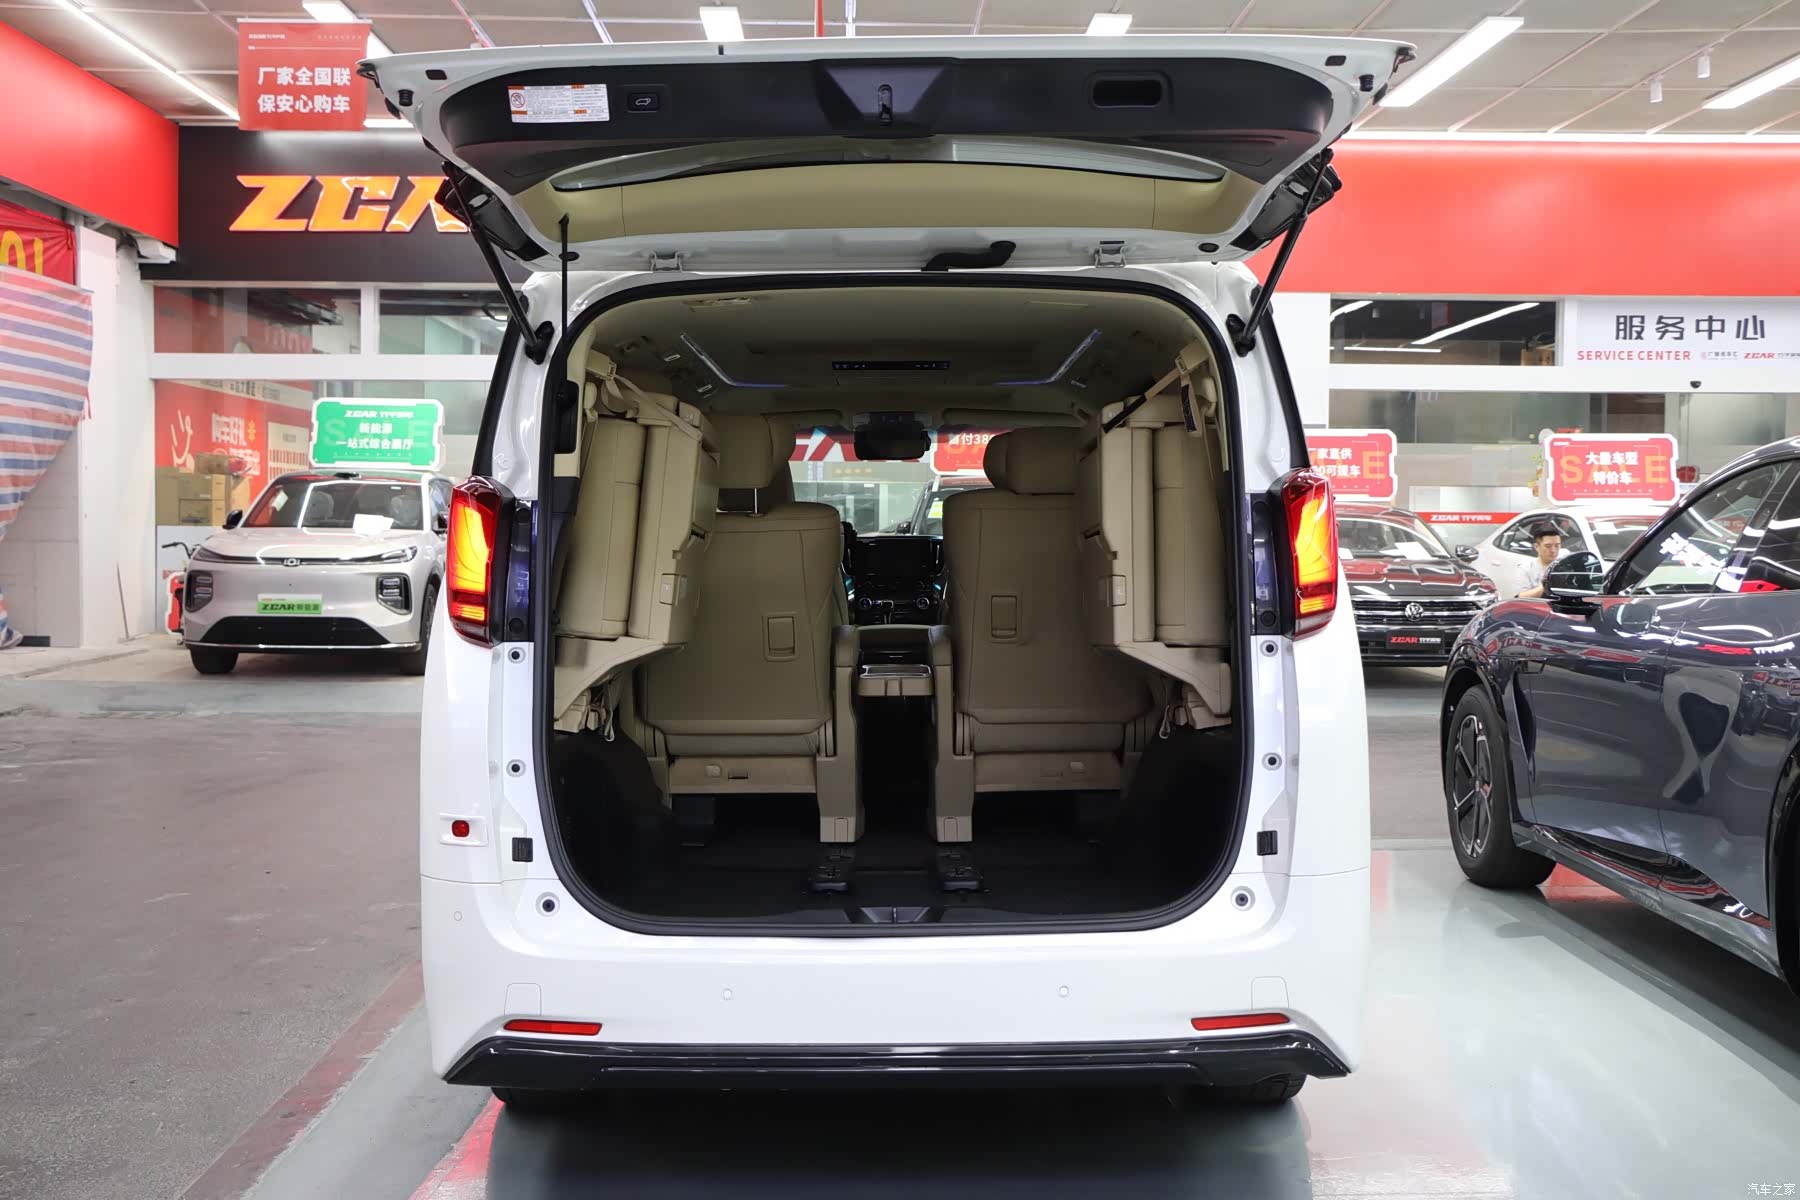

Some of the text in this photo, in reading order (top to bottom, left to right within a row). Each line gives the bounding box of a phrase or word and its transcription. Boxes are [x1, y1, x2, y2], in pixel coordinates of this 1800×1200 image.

[257, 67, 351, 86] 厂家全国联
[257, 94, 351, 113] 保安心购车
[229, 175, 471, 233] ZCA
[1615, 315, 1766, 341] 服务中心
[1577, 350, 1691, 361] SERVICE CENTER
[359, 422, 393, 434] 新能源
[335, 437, 414, 450] 一站式综合展厅
[1585, 451, 1639, 466] 大量车型
[1592, 470, 1633, 485] 特价车
[262, 603, 295, 611] ZCAR
